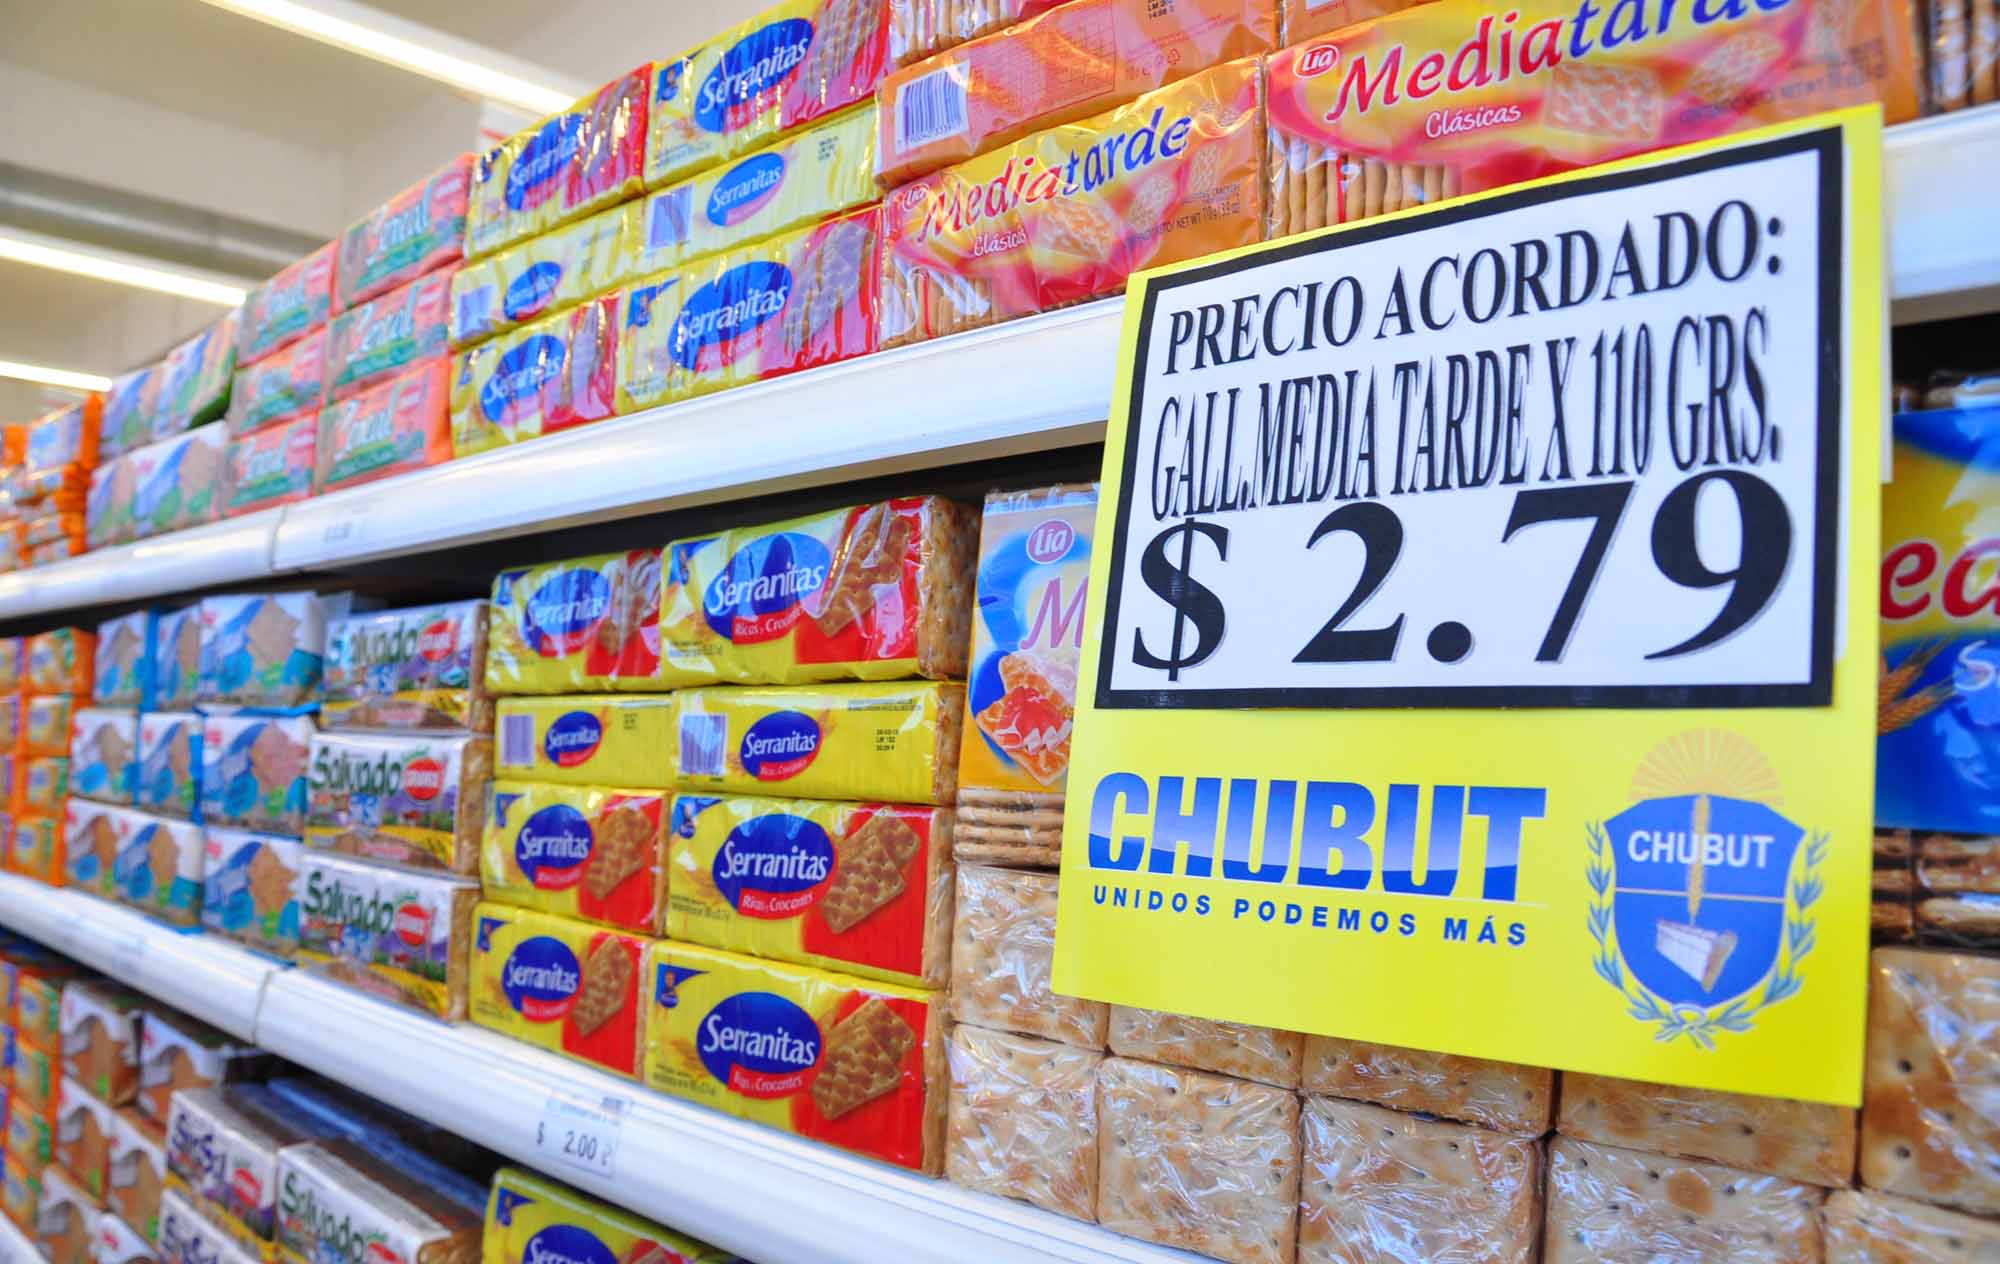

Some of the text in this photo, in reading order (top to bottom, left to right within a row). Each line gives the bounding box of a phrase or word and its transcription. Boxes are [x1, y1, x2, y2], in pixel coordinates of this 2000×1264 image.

[700, 38, 809, 114] Serranitas
[1303, 48, 1333, 71] Lia
[1326, 0, 1790, 122] Mediatar
[1426, 104, 1522, 138] Clásicas
[711, 165, 782, 212] Serranitas
[918, 107, 1193, 242] Mediatarde
[1163, 199, 1783, 375] PRECIO ACORDADO:
[678, 285, 788, 346] Serranitas
[1391, 345, 1532, 493] TARDE
[1539, 338, 1577, 481] X
[1588, 323, 1653, 477] 110
[1668, 307, 1780, 473] GRS.
[1036, 528, 1067, 556] Lia
[707, 563, 825, 615] Serranitas
[1132, 469, 1793, 682] $ 2.79
[743, 730, 817, 758] Serranitas
[720, 840, 829, 881] Serranitas
[1088, 772, 1548, 903] CHUBUT
[1627, 829, 1775, 869] CHUBUT
[1093, 886, 1528, 948] UNIDOS PODEMOS MÁS
[704, 1013, 816, 1066] Serranitas
[563, 1130, 599, 1161] 2.00
